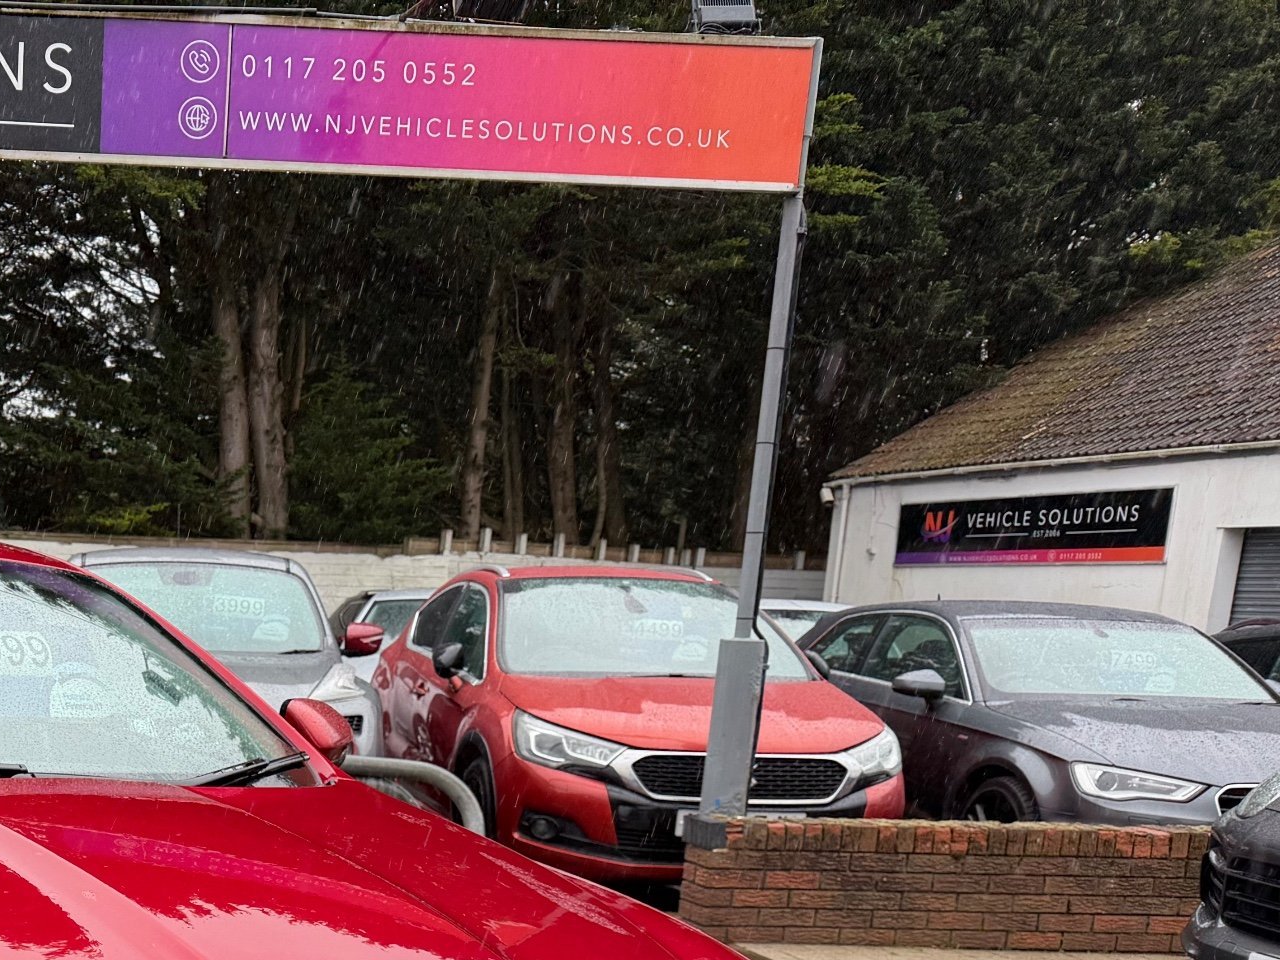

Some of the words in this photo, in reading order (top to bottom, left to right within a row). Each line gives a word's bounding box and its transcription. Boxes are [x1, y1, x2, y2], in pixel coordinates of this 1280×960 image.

[242, 54, 315, 79] 0117
[332, 58, 385, 83] 205
[403, 61, 476, 86] 0552
[239, 110, 731, 150] WWW.NJVEHICLESOLUTIONS.CO.UK
[967, 510, 1032, 528] VEHICLE
[1038, 504, 1140, 526] SOLUTIONS
